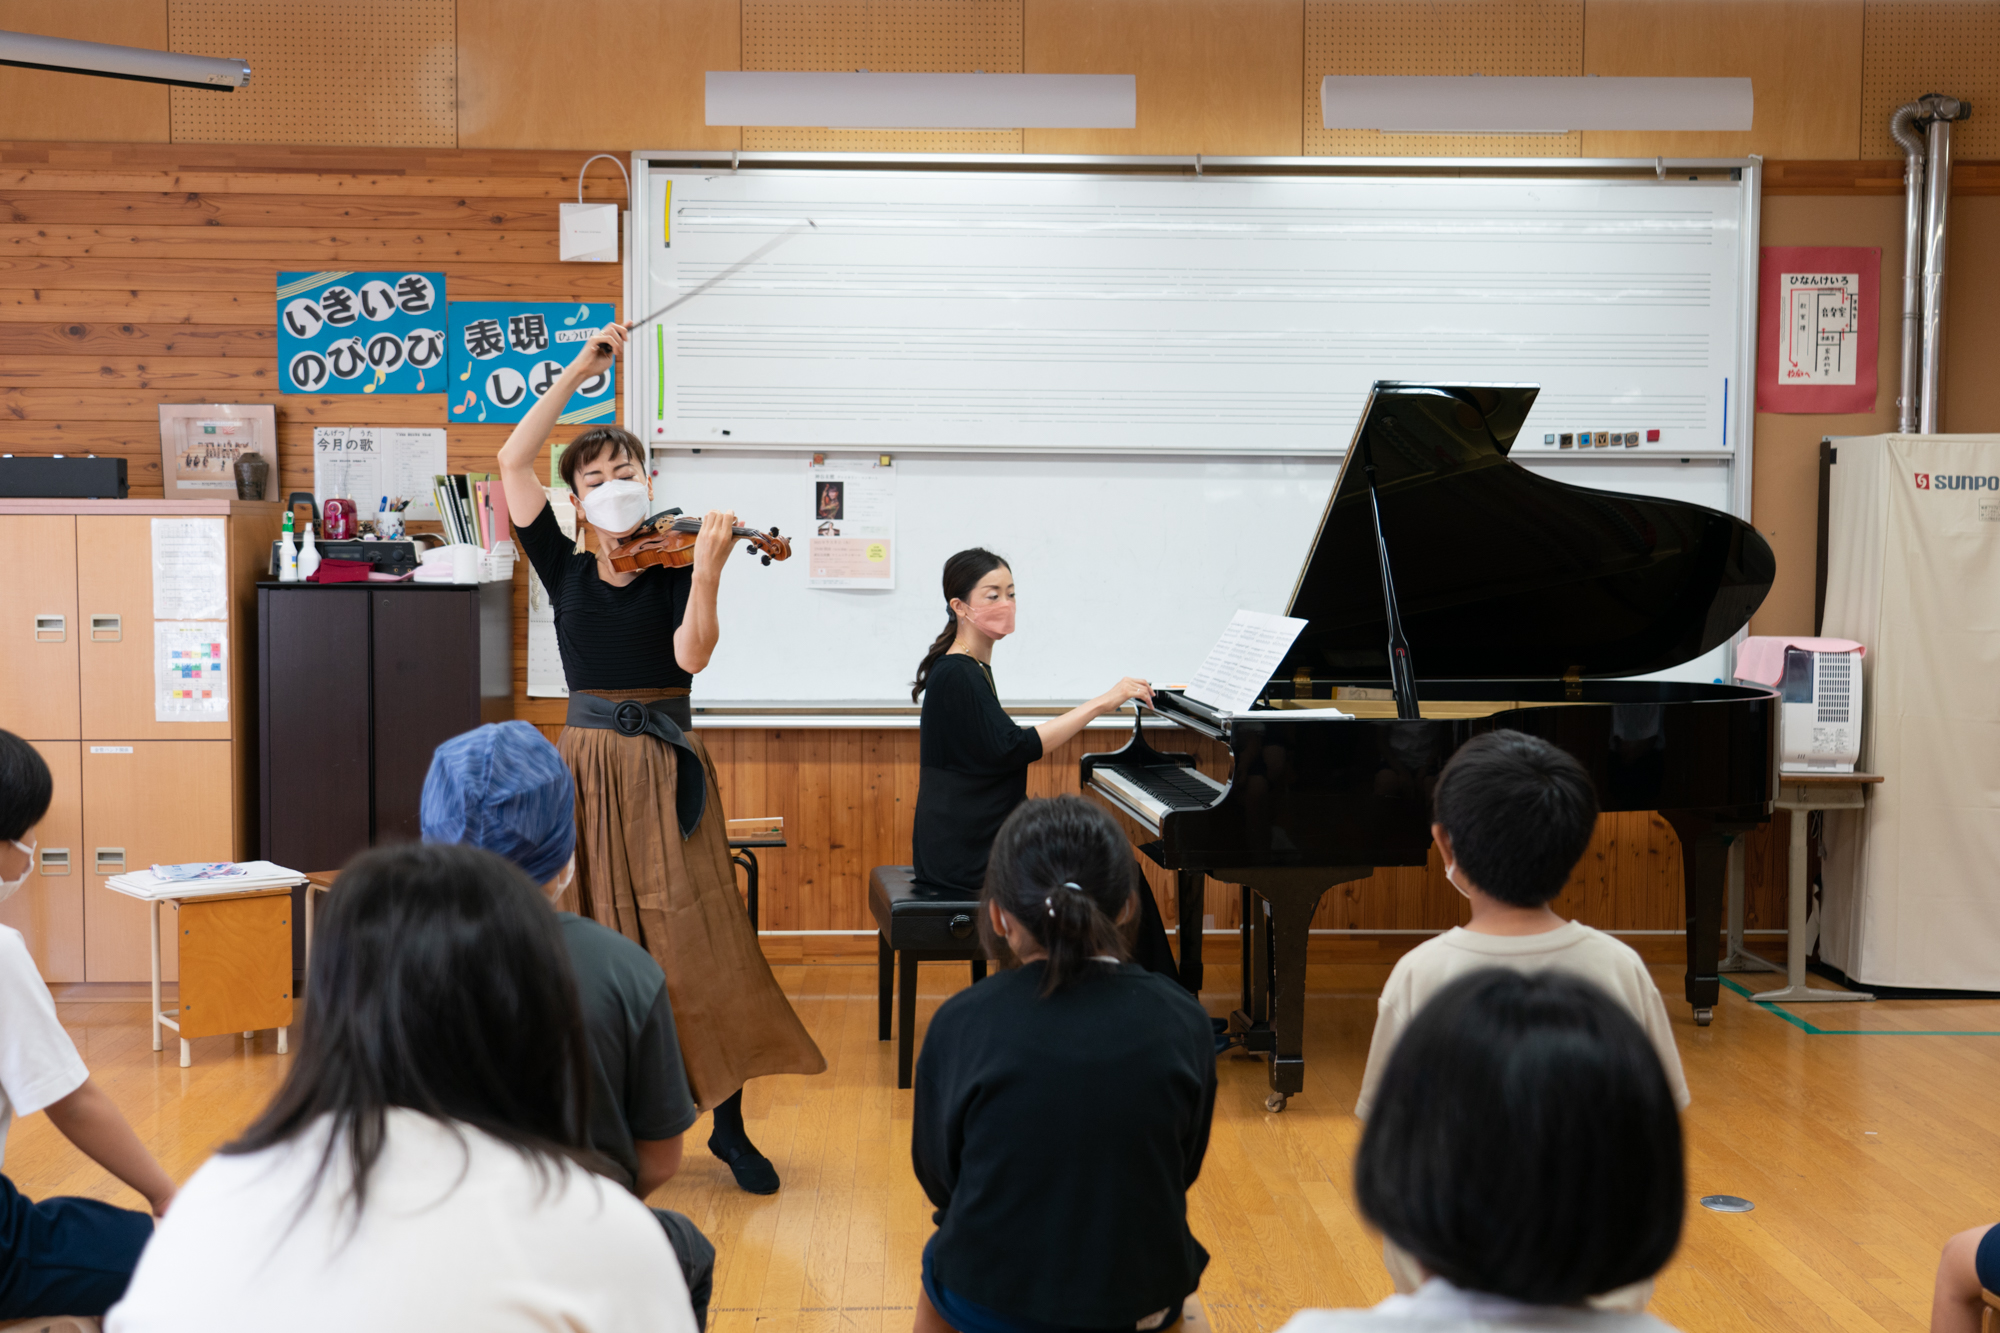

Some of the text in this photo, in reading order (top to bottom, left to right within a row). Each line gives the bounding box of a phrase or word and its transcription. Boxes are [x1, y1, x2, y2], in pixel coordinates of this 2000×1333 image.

[1790, 275, 1849, 285] ひなんけいろ
[285, 277, 431, 337] いきいき
[464, 314, 550, 358] 表現
[292, 331, 444, 387] のびのび
[317, 429, 373, 437] こんげつ うた
[317, 437, 374, 452] 今月の歌
